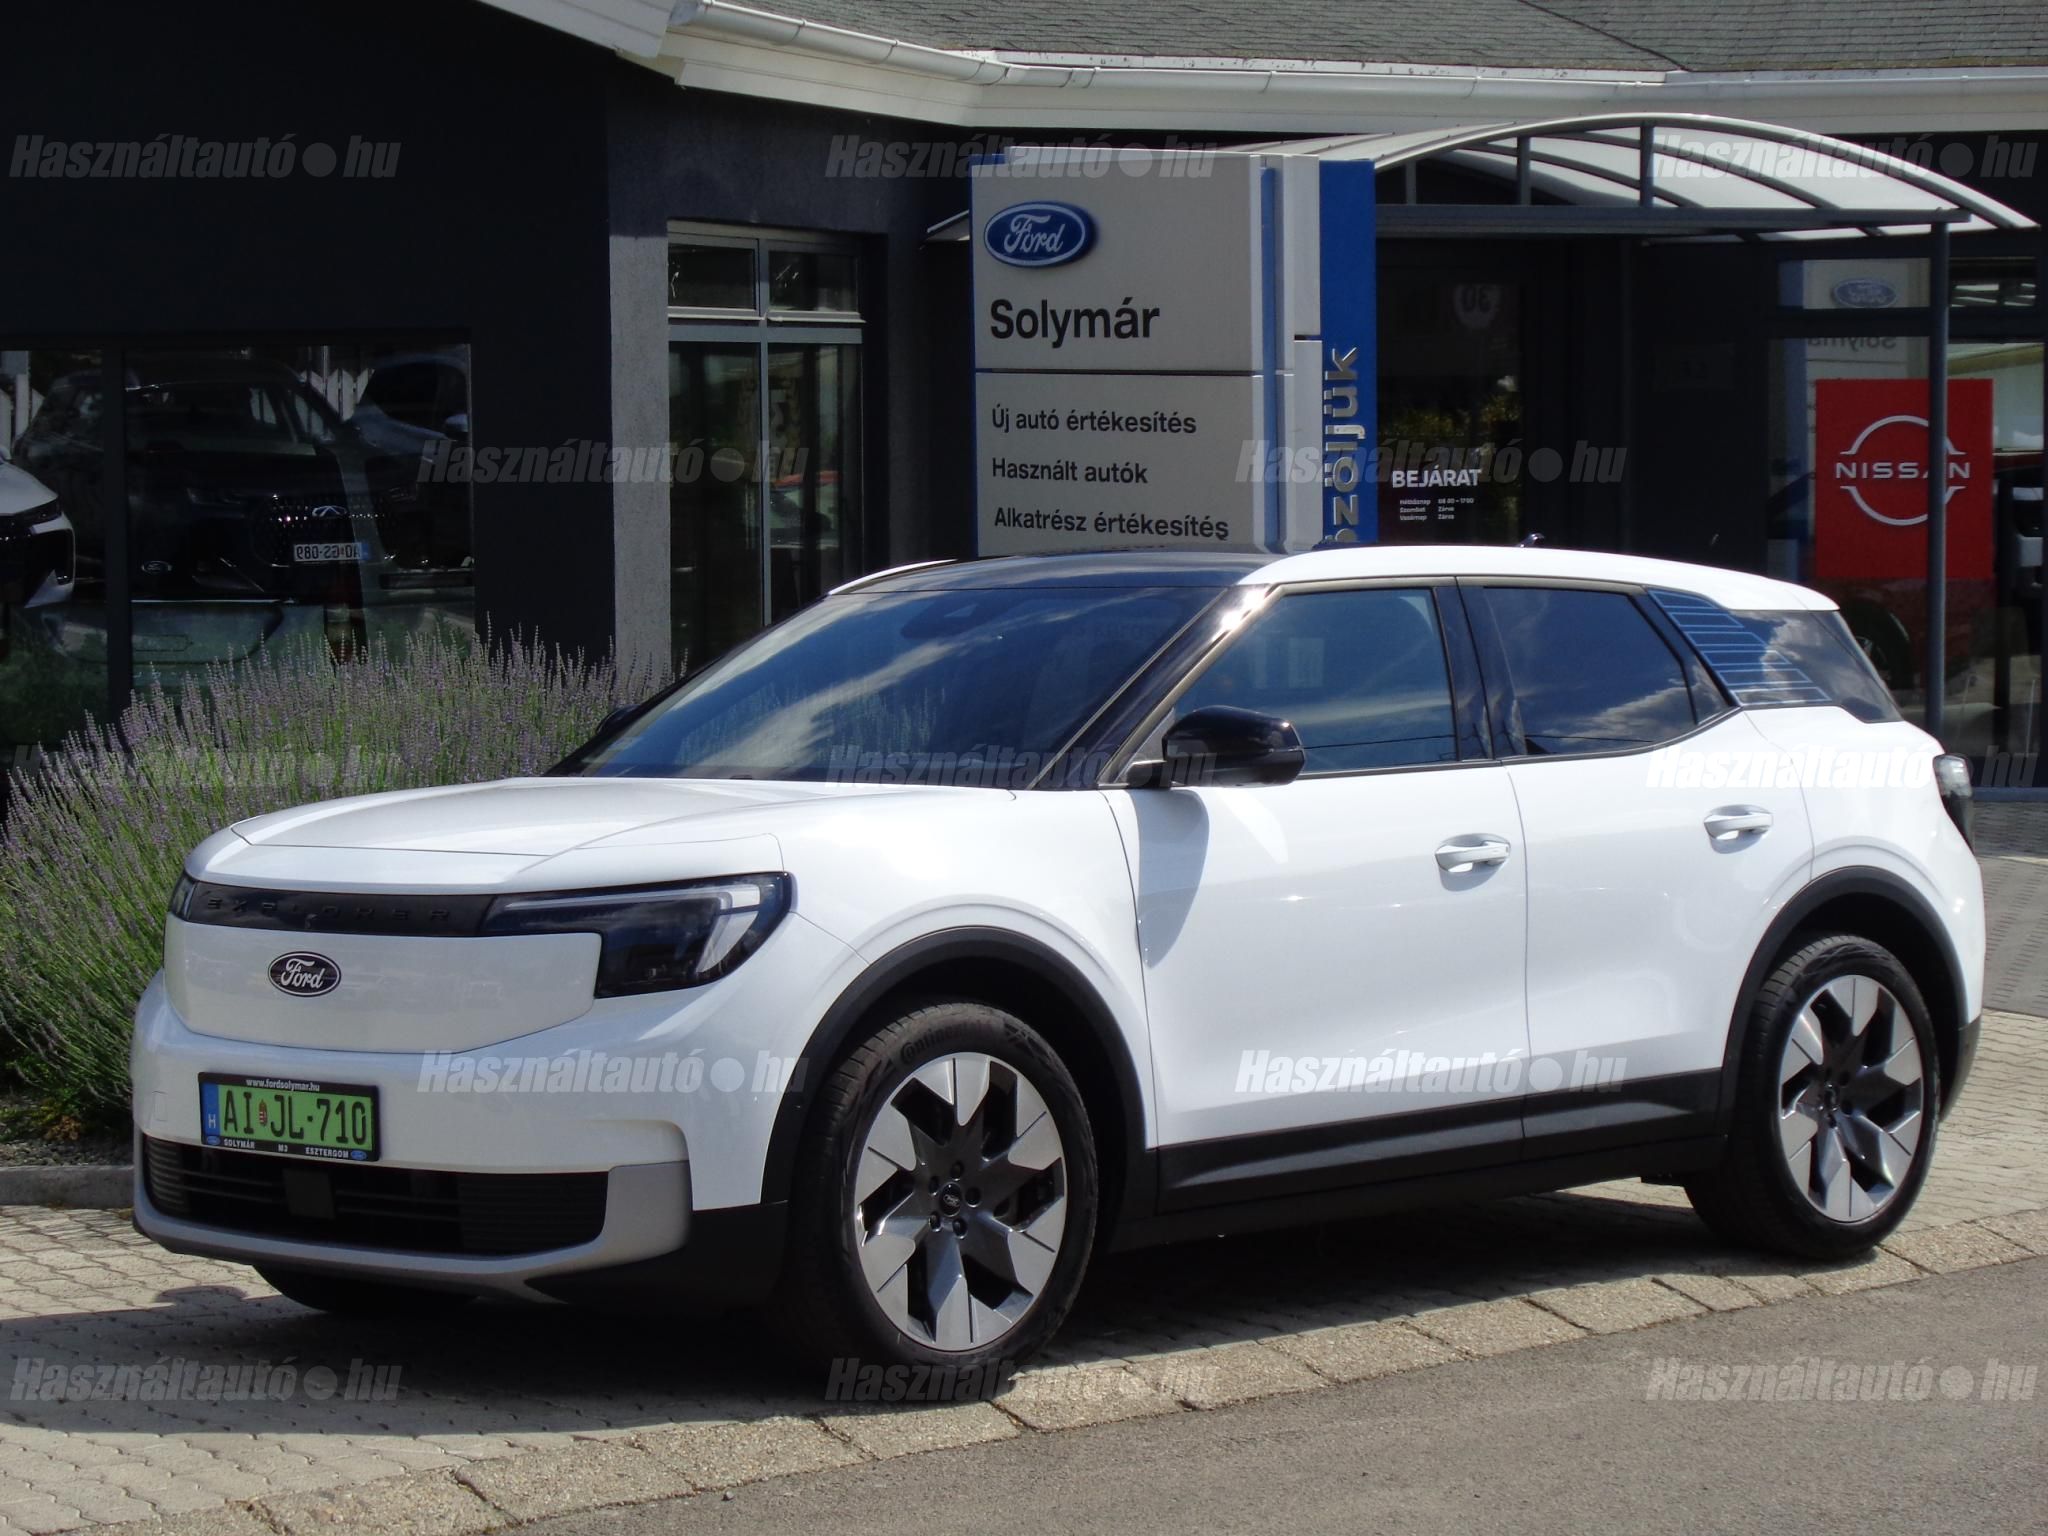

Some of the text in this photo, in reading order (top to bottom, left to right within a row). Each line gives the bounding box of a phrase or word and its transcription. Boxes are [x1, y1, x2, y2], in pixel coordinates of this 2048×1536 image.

[1003, 213, 1066, 254] Ford
[990, 297, 1160, 349] Solymár
[992, 404, 1197, 434] Új autó értékesítés
[992, 458, 1148, 483] Használt autók
[1392, 465, 1482, 488] BEJÁRAT
[1836, 462, 1970, 480] NISSN
[994, 507, 1229, 539] Alkatrész értékesítés
[281, 958, 325, 989] Ford
[207, 1113, 217, 1129] H
[223, 1137, 255, 1149] SOLYMÁR
[305, 1146, 349, 1159] ESZTERGOM
